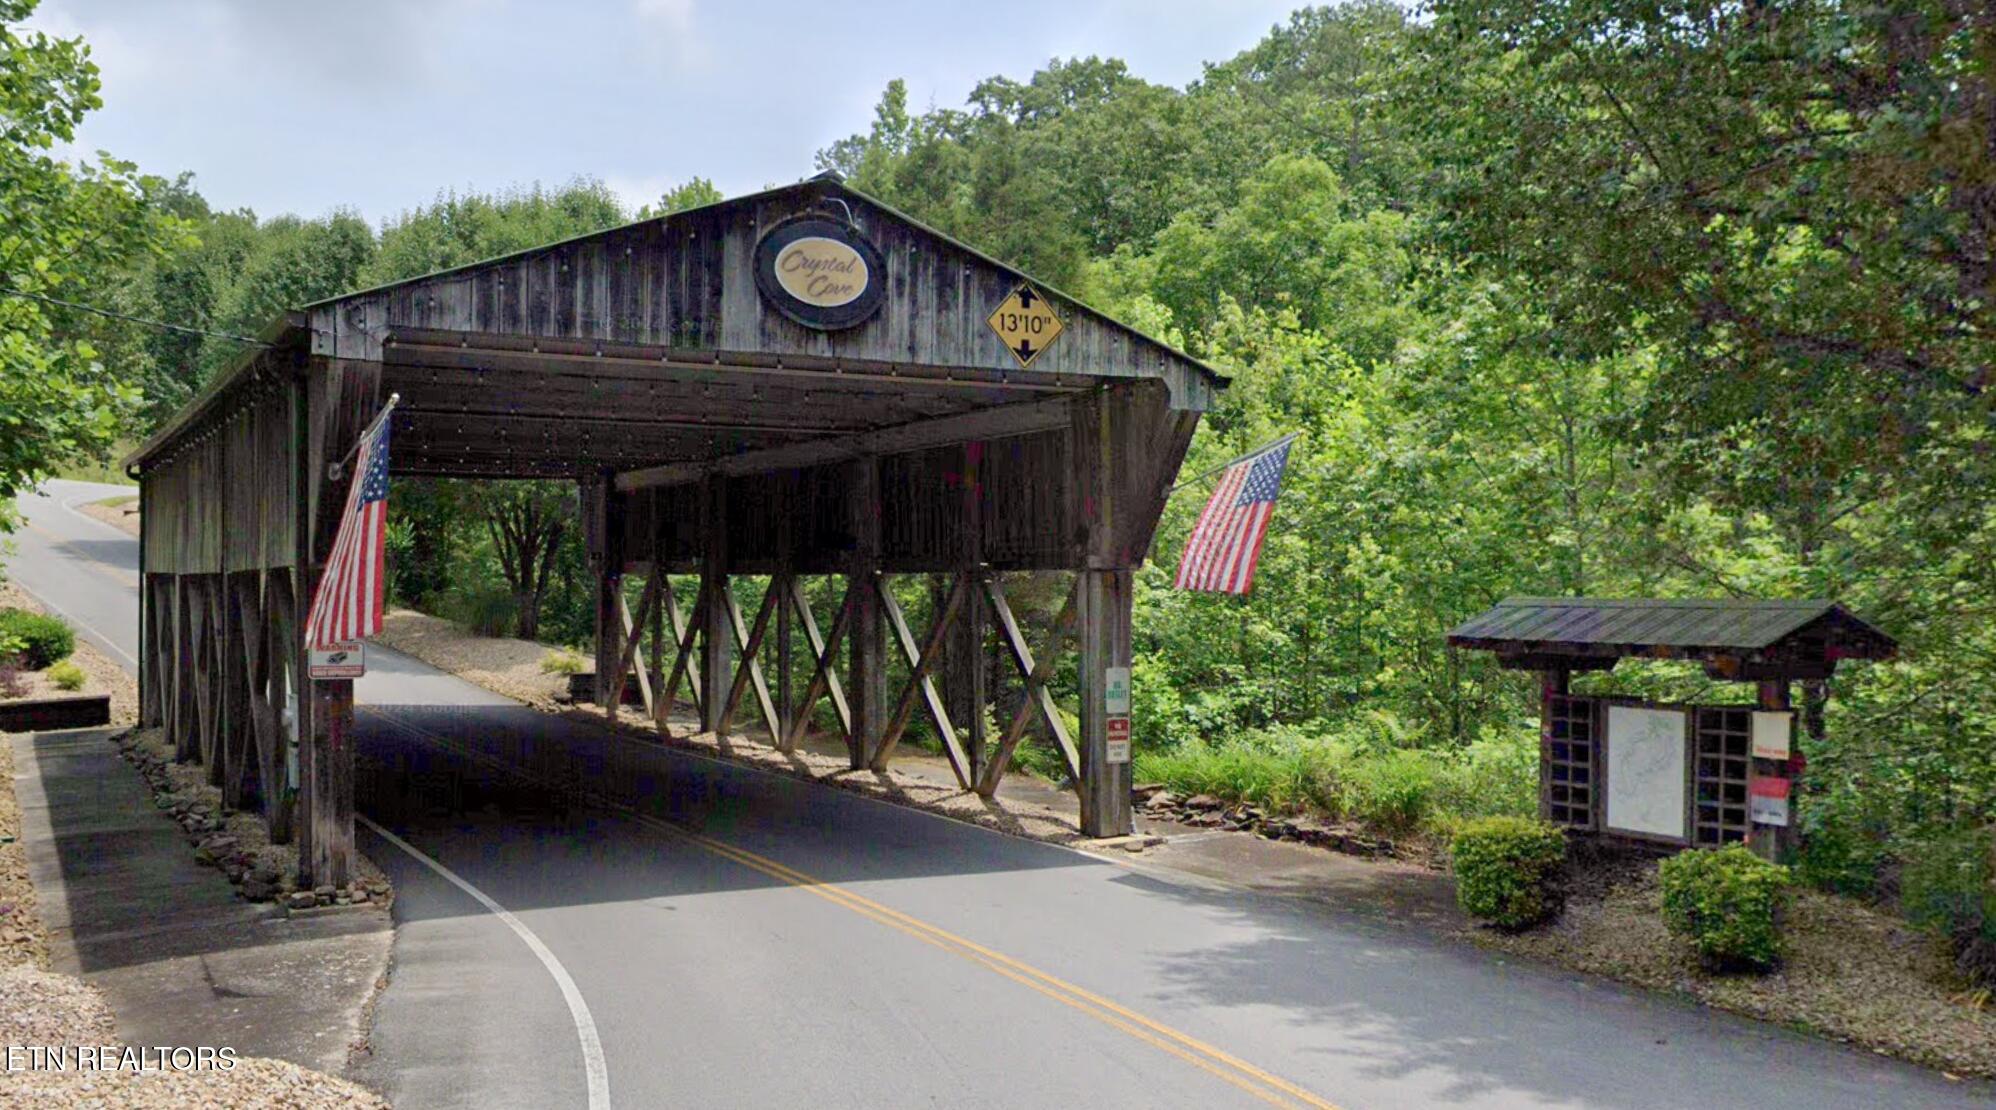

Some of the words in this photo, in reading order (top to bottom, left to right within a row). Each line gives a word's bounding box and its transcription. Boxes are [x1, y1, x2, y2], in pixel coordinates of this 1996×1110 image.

[781, 250, 857, 277] Crystal
[807, 275, 853, 297] Cove
[1000, 313, 1051, 334] 13'10"
